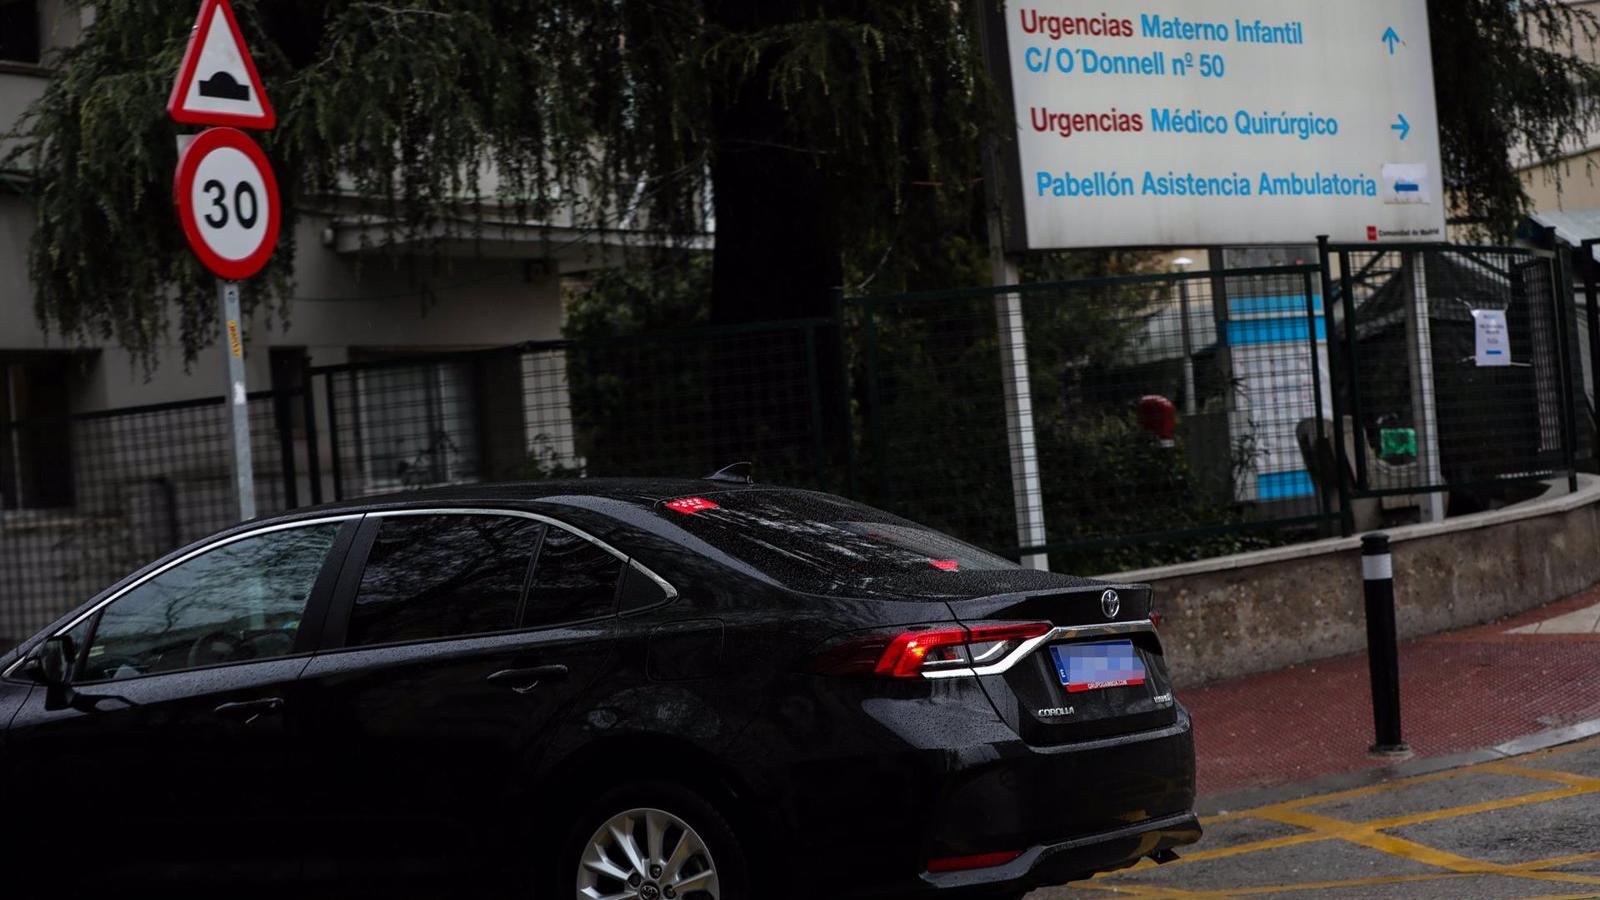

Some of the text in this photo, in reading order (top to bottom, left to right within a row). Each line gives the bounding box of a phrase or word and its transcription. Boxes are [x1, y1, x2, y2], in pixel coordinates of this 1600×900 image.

[1020, 9, 1303, 44] Urgencias Materno Infantil
[1200, 54, 1225, 77] 50
[1030, 107, 1338, 140] Urgencias Médico Quirúrgico
[1037, 171, 1377, 197] Pabellón Asistencia Ambulatoria
[203, 179, 258, 229] 30
[1038, 706, 1075, 717] COROLLA
